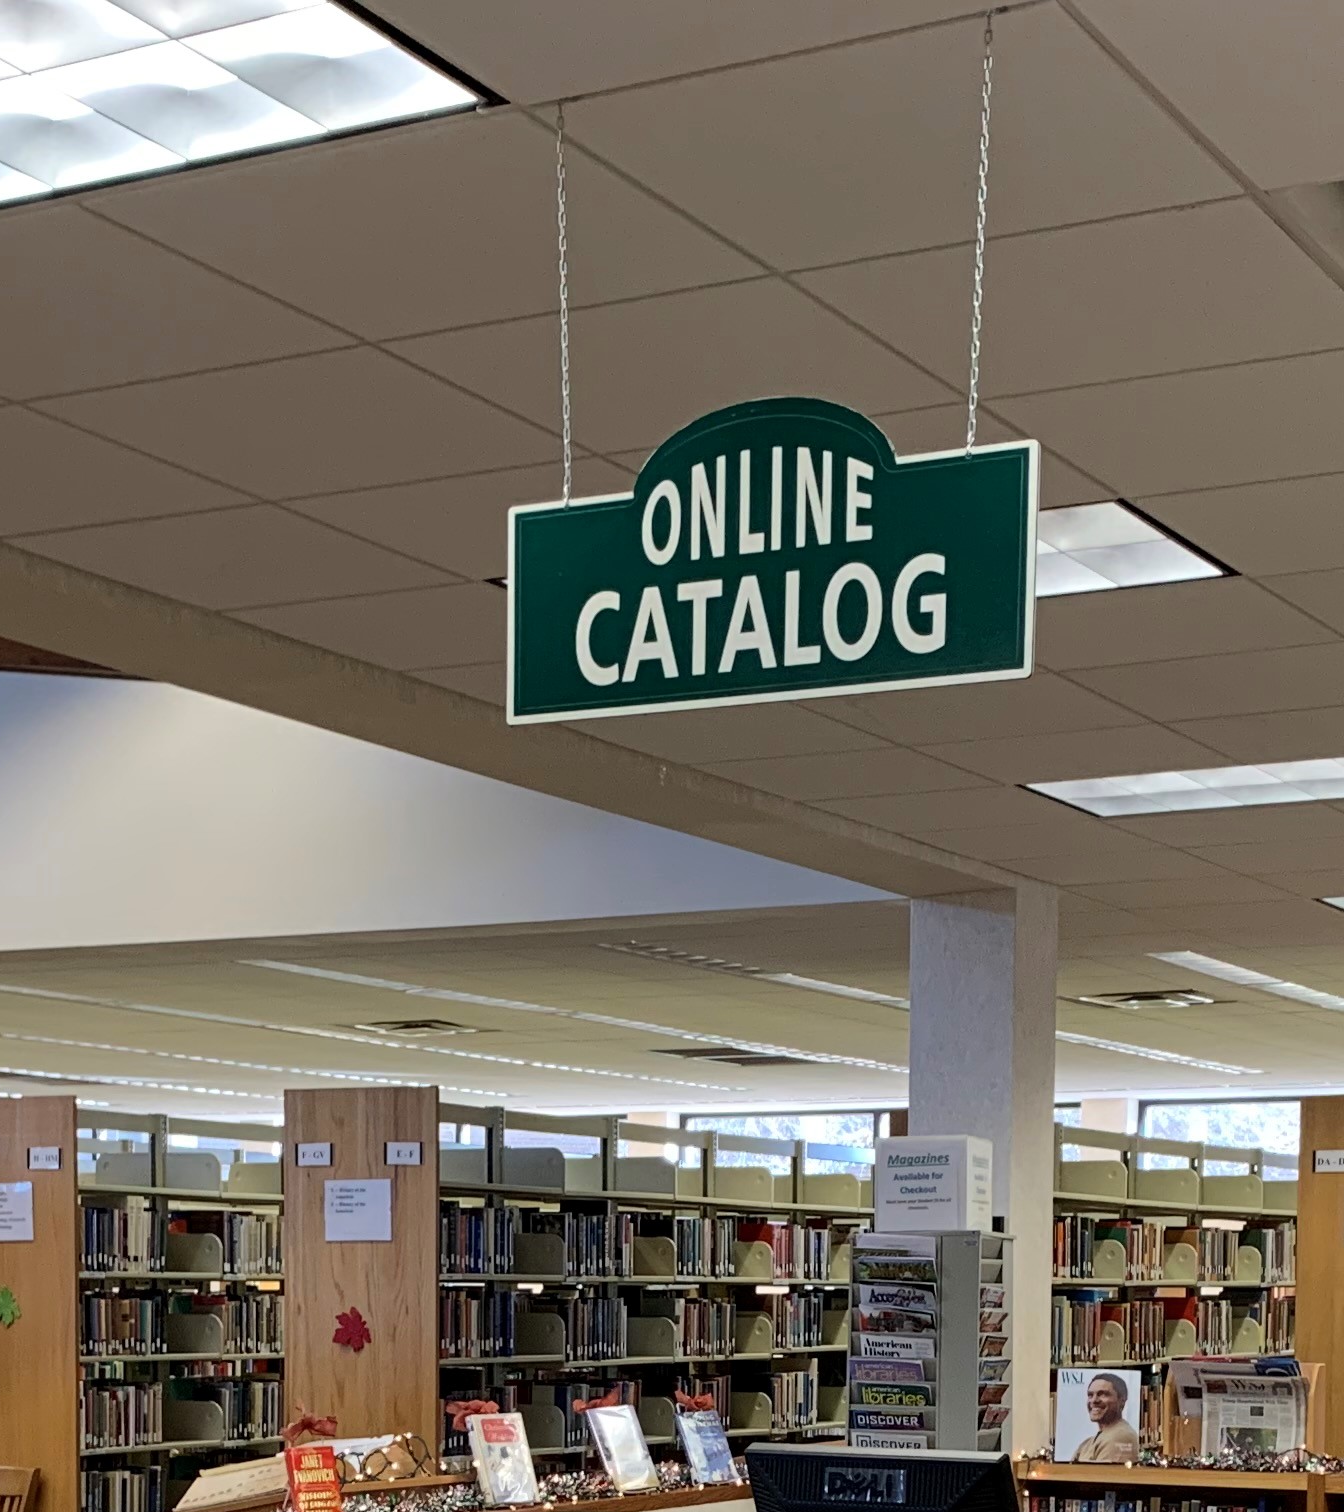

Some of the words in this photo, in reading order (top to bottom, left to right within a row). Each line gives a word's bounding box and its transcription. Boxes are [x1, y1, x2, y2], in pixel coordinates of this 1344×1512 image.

[641, 446, 874, 566] ONLINE
[575, 553, 947, 686] CATALOG
[887, 1153, 950, 1166] Magazines
[1317, 1157, 1331, 1166] DA
[893, 1171, 930, 1181] Available
[931, 1171, 944, 1180] for
[900, 1186, 937, 1194] Checkout
[866, 1338, 912, 1349] American
[864, 1346, 900, 1357] History
[861, 1387, 926, 1406] libraries
[857, 1414, 920, 1427] DISCOVER
[300, 1453, 323, 1469] JANET
[826, 1470, 896, 1500] DELL
